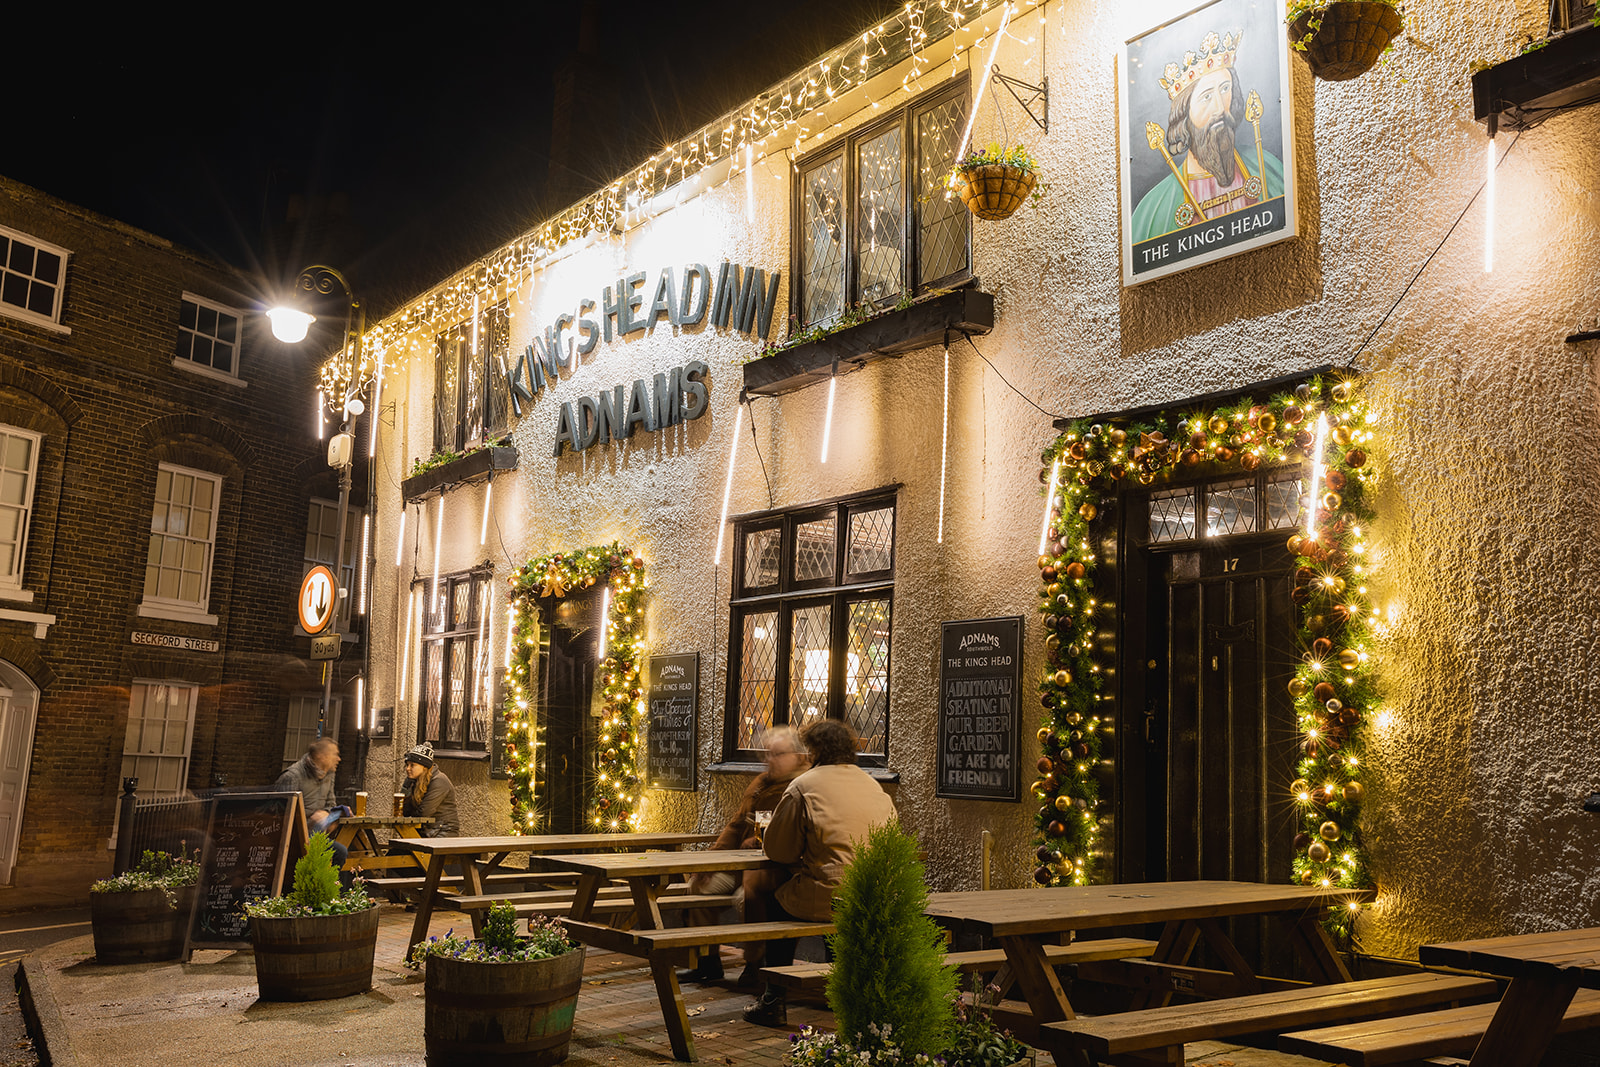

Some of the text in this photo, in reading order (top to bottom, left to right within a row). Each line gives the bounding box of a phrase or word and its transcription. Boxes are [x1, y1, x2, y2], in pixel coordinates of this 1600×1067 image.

[1142, 210, 1273, 264] THE KINGS HEAD
[506, 262, 781, 418] KINGS HEAD INN
[553, 361, 709, 457] ADNAMS
[1223, 558, 1239, 572] 17
[134, 633, 216, 651] SECKFORD STREET
[959, 632, 1000, 650] ADNAMS
[948, 655, 1012, 668] THE KINGS HEAD
[660, 664, 685, 678] ADNAMS
[653, 682, 692, 692] THE KINGS HEAD
[948, 680, 1010, 697] ADDITIONAL
[947, 697, 1011, 715] SEATING IN
[947, 716, 1011, 733] OUR BEER
[949, 734, 1002, 752] GARDEN
[946, 753, 1010, 769] WE ARE DOG
[948, 770, 1004, 786] FRIENDLY
